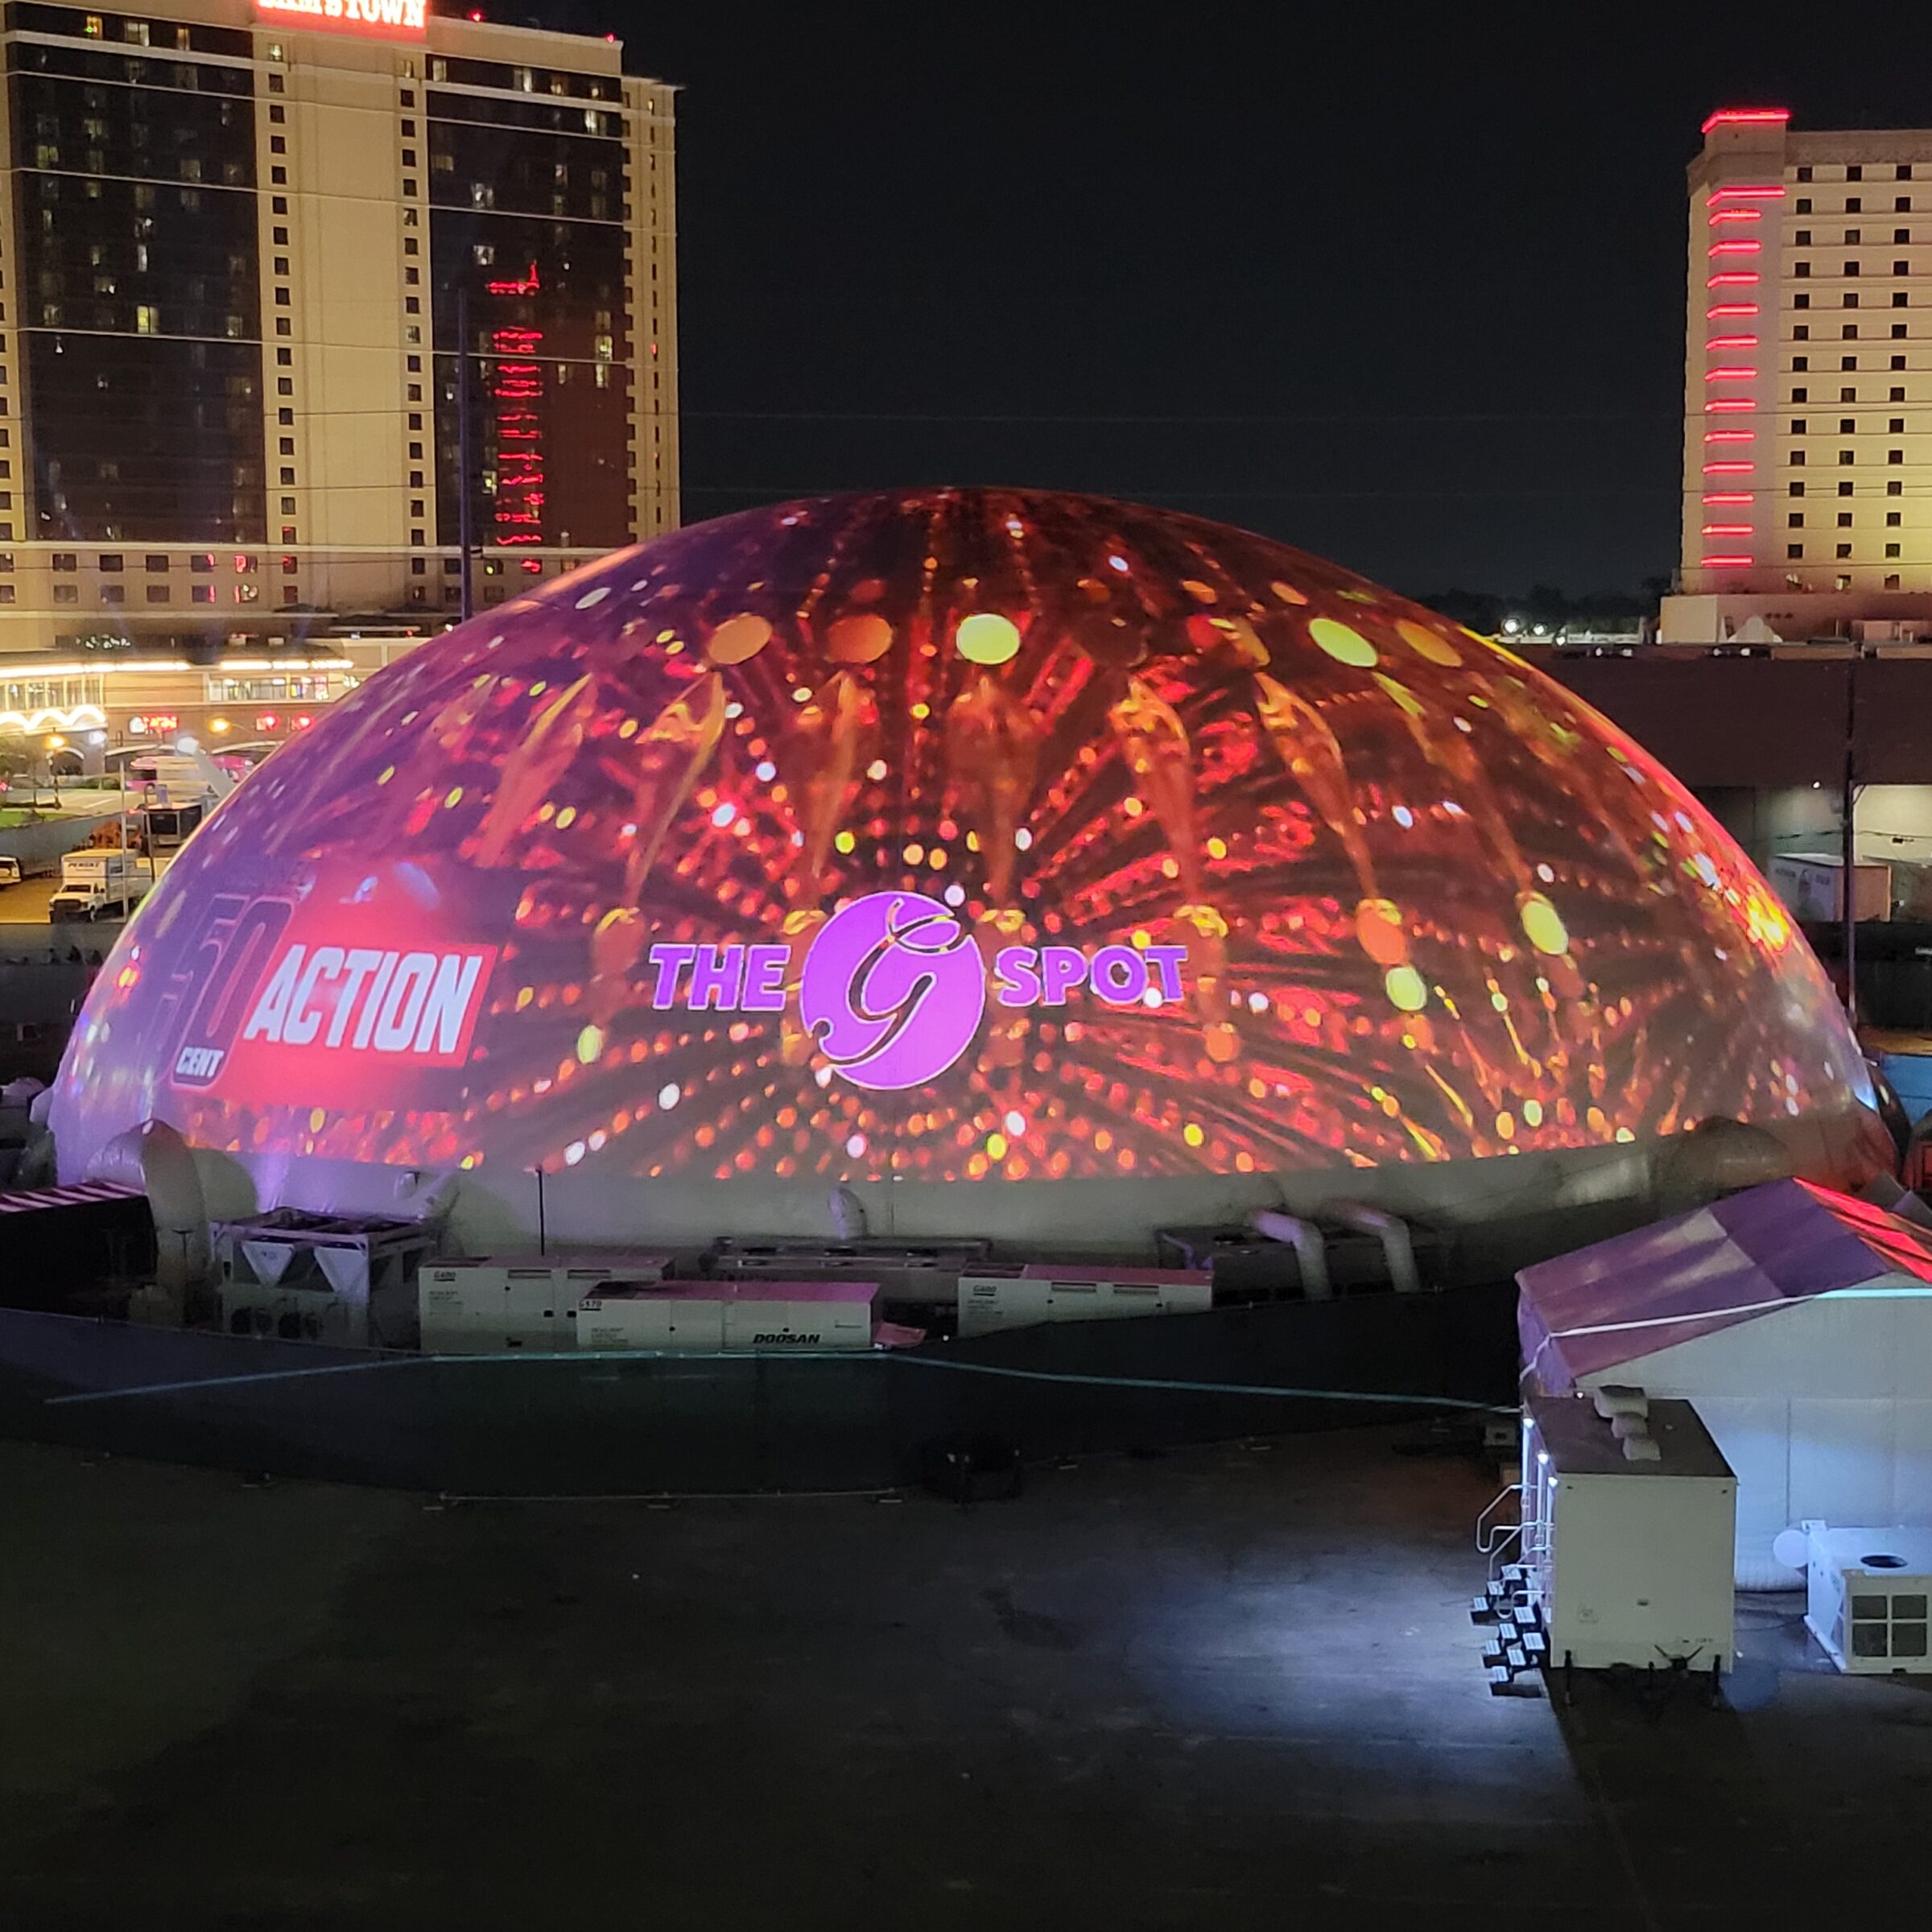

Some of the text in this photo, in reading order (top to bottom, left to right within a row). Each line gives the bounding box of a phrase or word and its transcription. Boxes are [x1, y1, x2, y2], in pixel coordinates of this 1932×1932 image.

[243, 944, 481, 1054] ACTION
[649, 943, 791, 1011] THE
[993, 945, 1188, 1006] SPOT
[176, 1046, 224, 1077] CENT
[753, 1334, 820, 1344] DOOSAN
